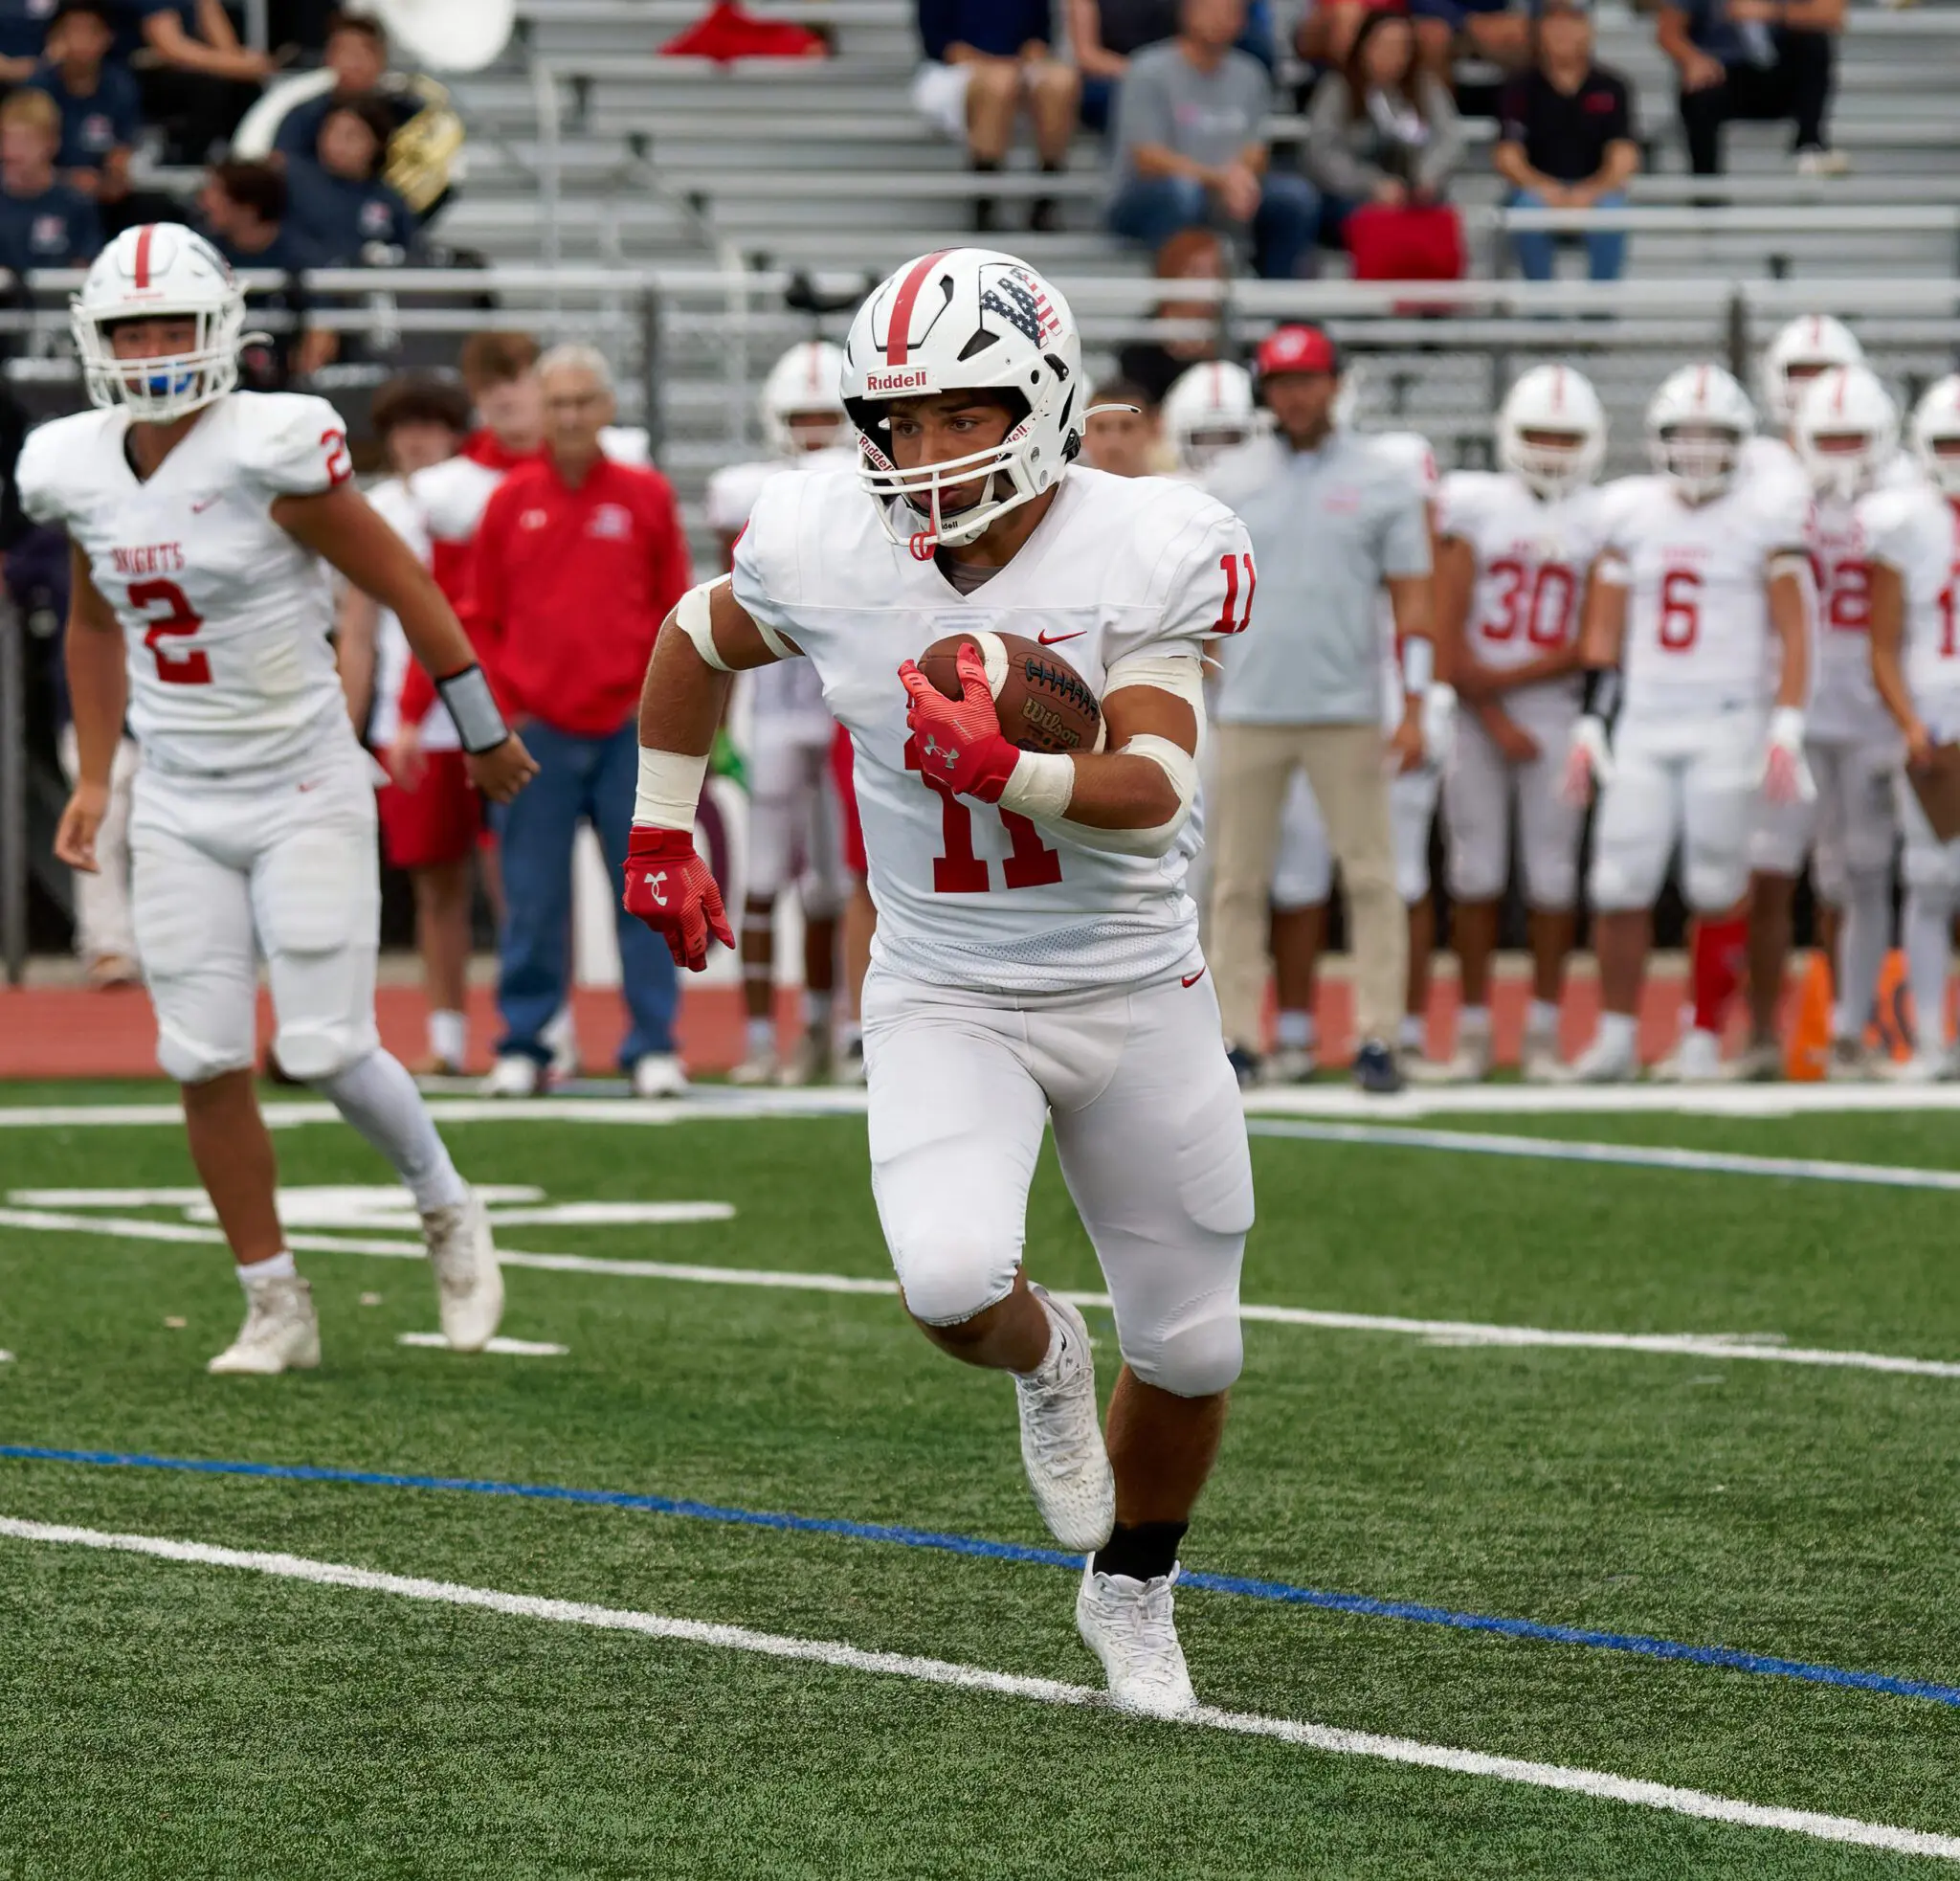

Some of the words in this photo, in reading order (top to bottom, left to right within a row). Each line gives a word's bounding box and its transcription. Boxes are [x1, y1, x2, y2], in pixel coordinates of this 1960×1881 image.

[867, 371, 926, 391] Riddell
[320, 428, 352, 486] 2
[127, 577, 214, 685] 2
[1210, 553, 1256, 634] 11
[1481, 559, 1574, 651] 30
[1659, 569, 1703, 653] 6
[1022, 697, 1080, 749] Wilson
[903, 732, 1063, 893] 11
